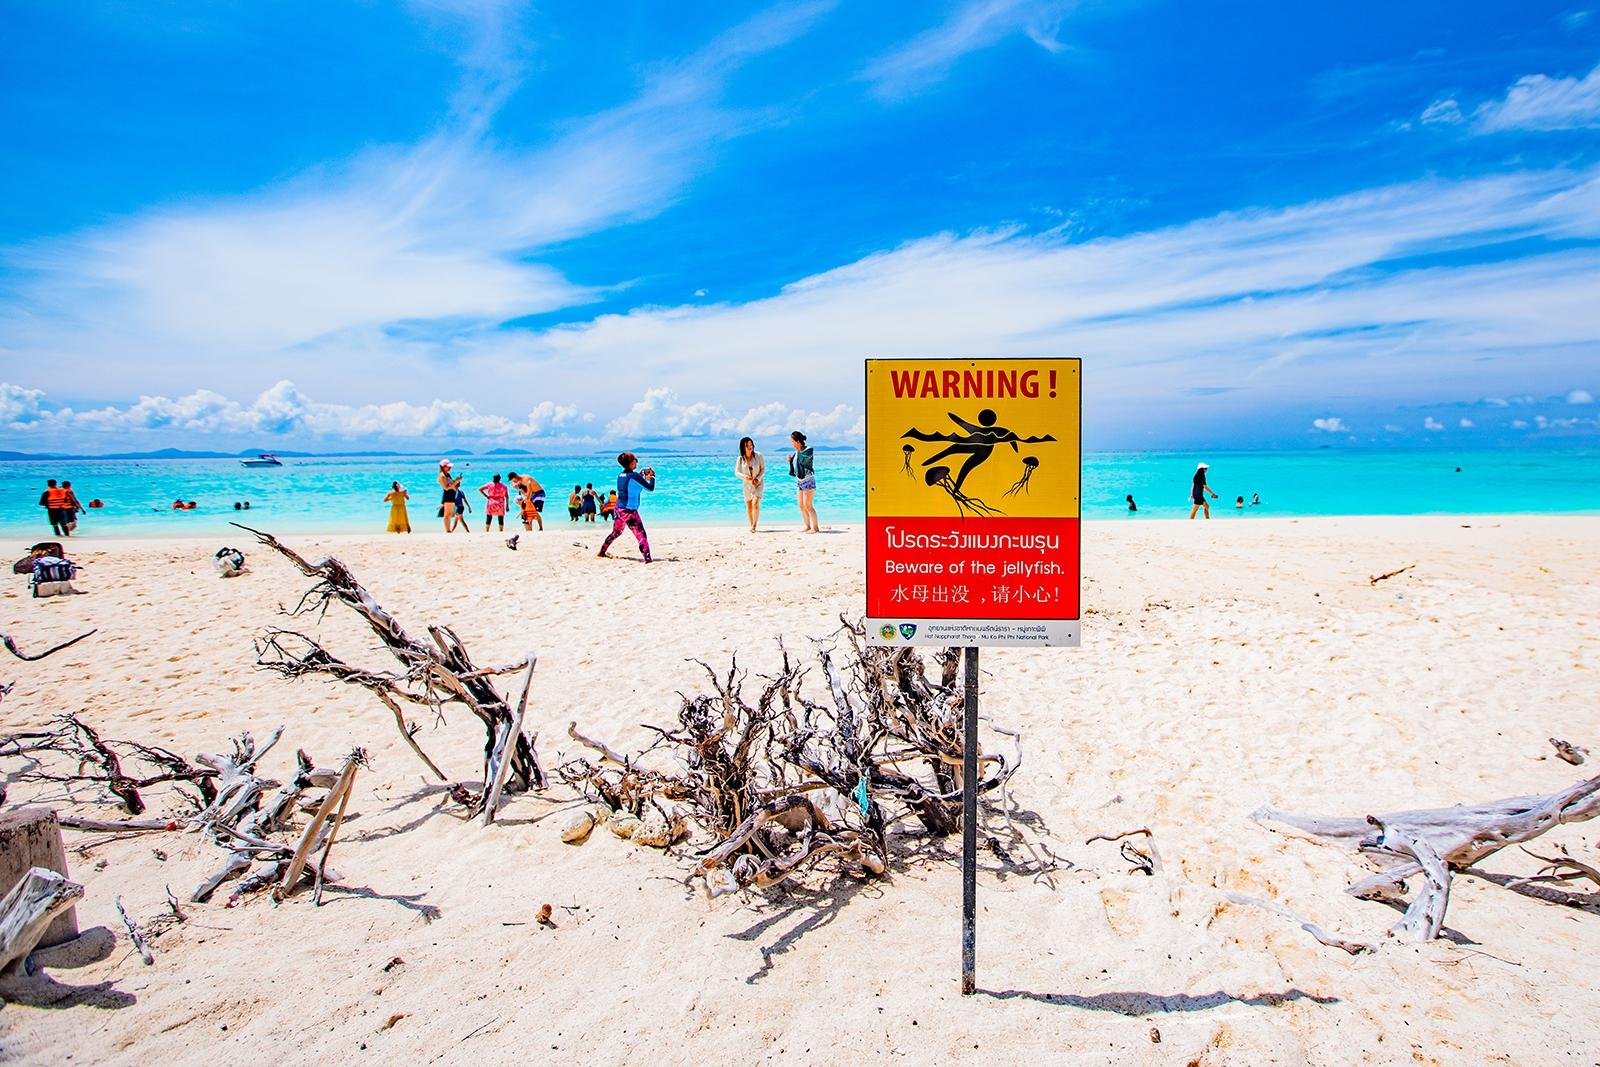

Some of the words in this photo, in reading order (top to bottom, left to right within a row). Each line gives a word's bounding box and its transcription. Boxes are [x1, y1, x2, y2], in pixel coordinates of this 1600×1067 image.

[886, 527, 1059, 555] โปรดระวังแมงกะพรุน
[886, 561, 943, 574] Beware
[949, 561, 966, 574] of
[970, 561, 996, 574] the
[1001, 561, 1065, 578] jellyfish.
